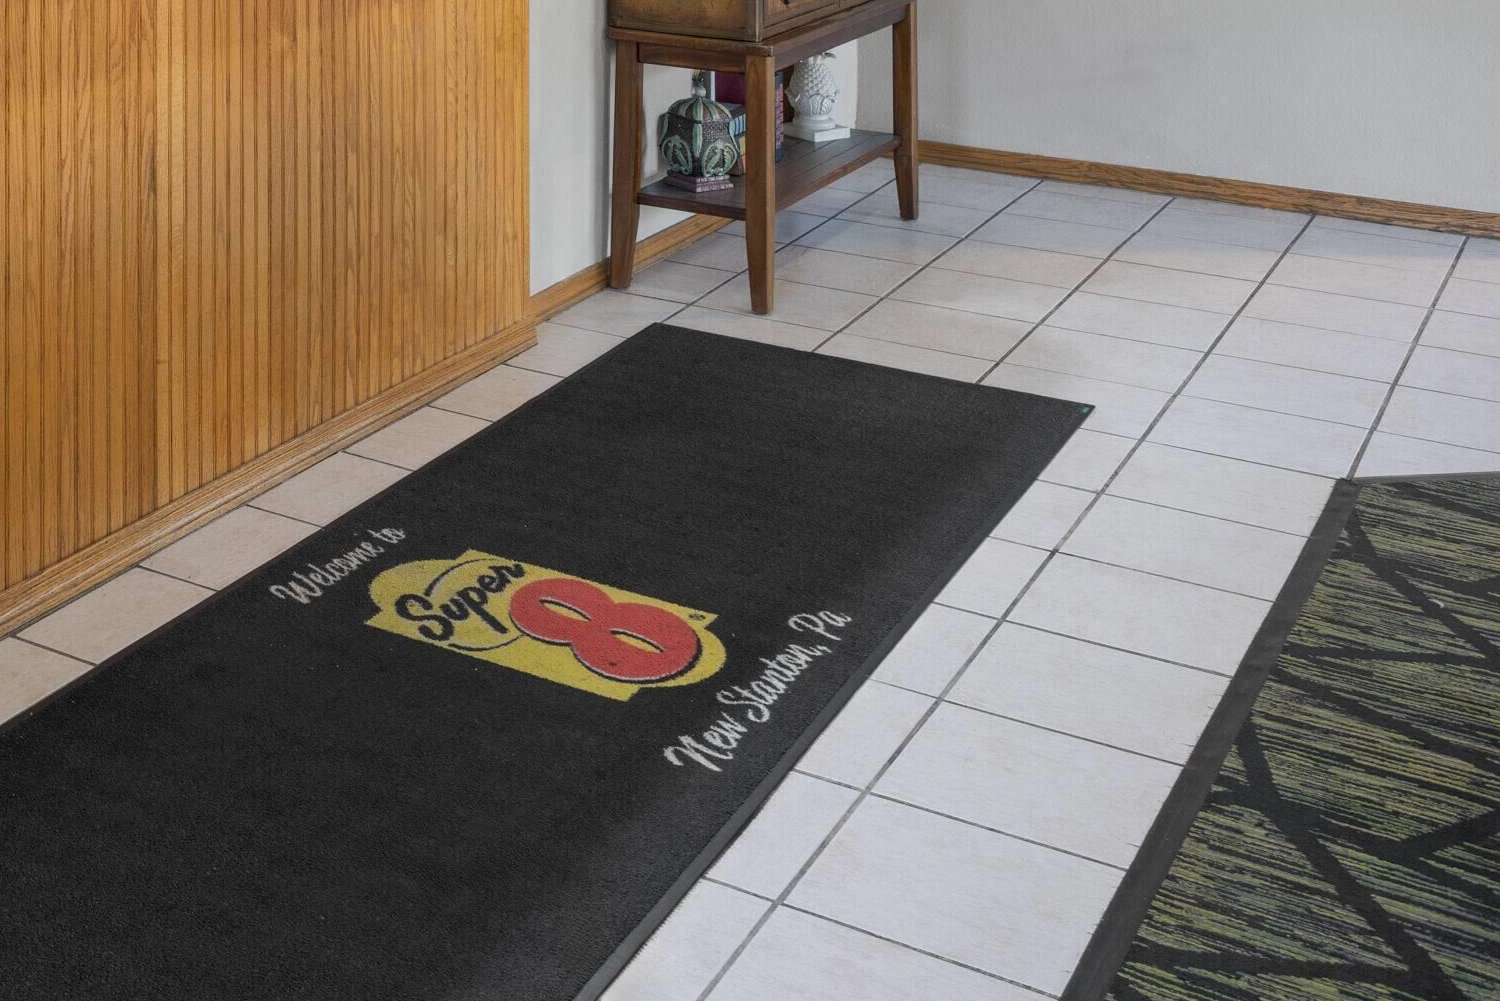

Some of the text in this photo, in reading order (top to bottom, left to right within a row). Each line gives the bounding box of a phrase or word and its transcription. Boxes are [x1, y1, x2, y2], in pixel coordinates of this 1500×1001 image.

[269, 525, 407, 604] Welcome to
[395, 560, 529, 642] Super
[509, 577, 704, 684] 8
[663, 604, 853, 773] New Stanton, Pa
